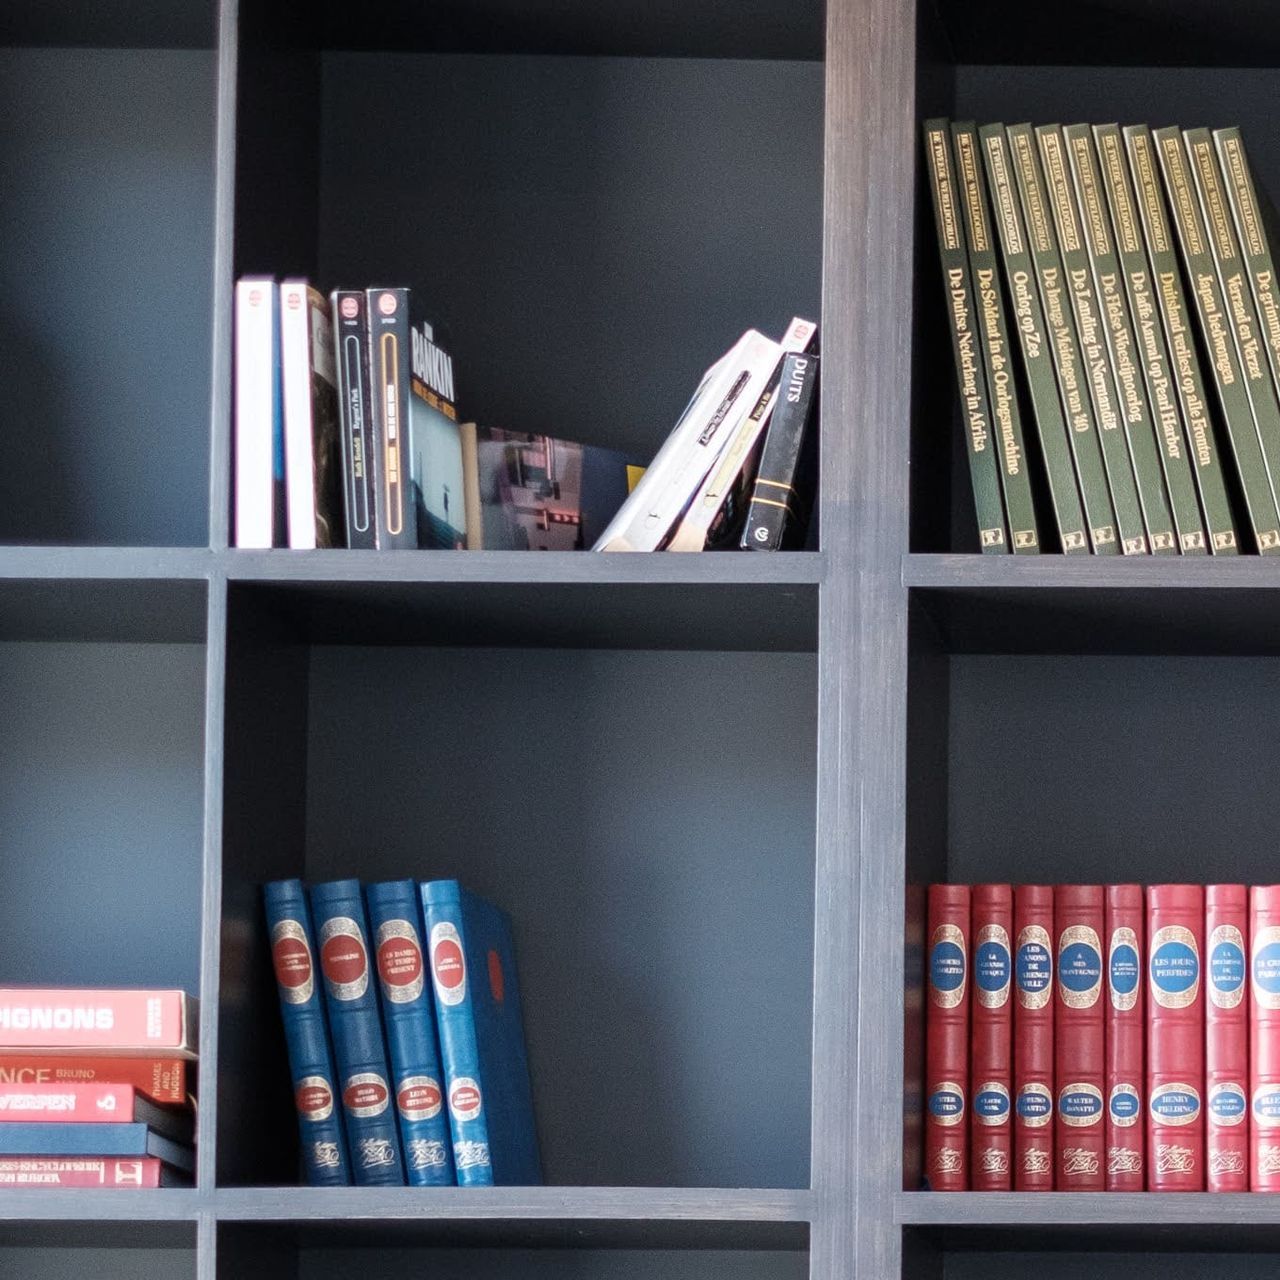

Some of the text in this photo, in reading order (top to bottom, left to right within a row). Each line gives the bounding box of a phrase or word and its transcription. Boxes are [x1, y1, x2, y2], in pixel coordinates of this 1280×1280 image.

[1011, 270, 1043, 358] Oorlog op Zee
[786, 357, 807, 403] DUITS
[947, 267, 988, 452] De Duitse Nederlaag in Afrika
[1130, 270, 1183, 460] De laffe Aanval op Pearl Harbor
[0, 1008, 114, 1029] IGNONS
[56, 1069, 95, 1078] BRUNO
[153, 1063, 162, 1096] THAMES
[171, 1063, 180, 1099] HUDSON
